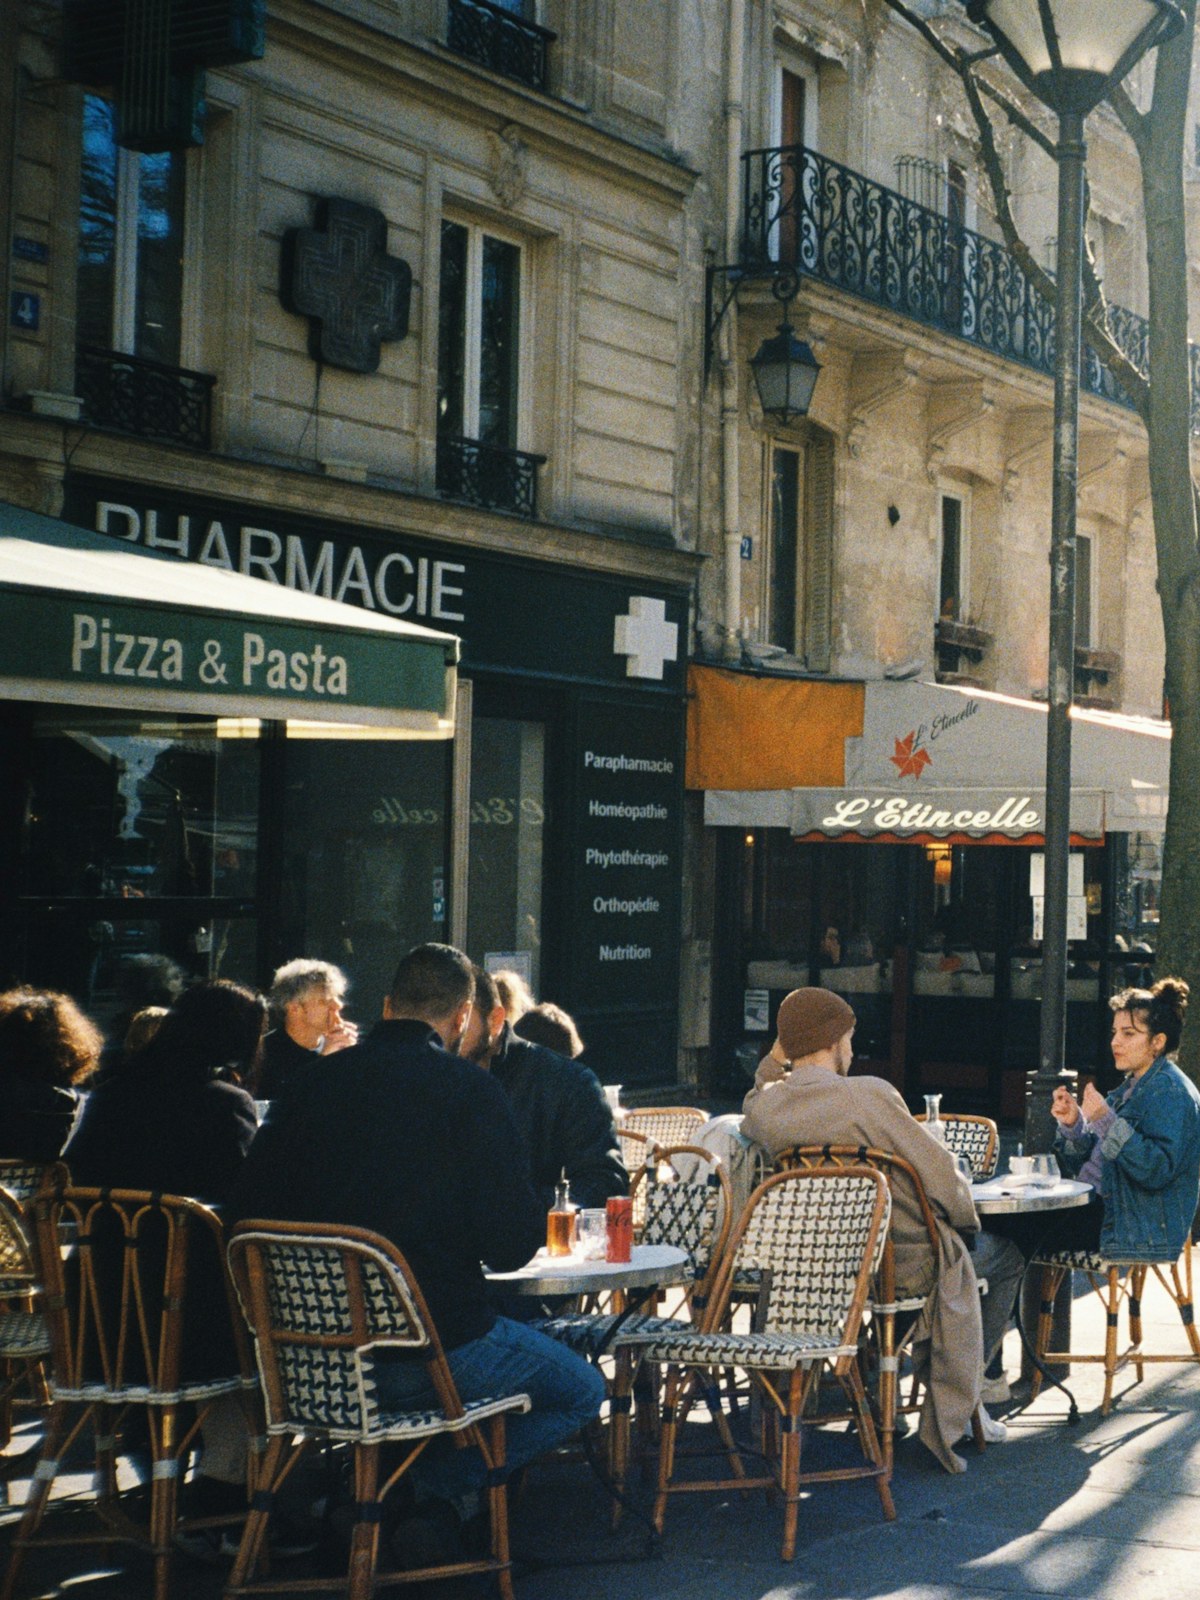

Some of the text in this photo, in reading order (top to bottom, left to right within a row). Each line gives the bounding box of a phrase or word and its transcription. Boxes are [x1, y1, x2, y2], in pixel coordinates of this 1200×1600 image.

[17, 297, 33, 324] 4
[96, 501, 465, 622] PHARMACIE
[72, 614, 348, 696] Pizza & Pasta
[584, 751, 674, 773] Parapharmacie
[589, 800, 668, 821] Homéopathie
[822, 797, 1041, 829] L'Etincelle
[586, 848, 669, 869] Phytothérapie
[593, 896, 660, 916] Orthopédie
[599, 944, 651, 961] Nutrition
